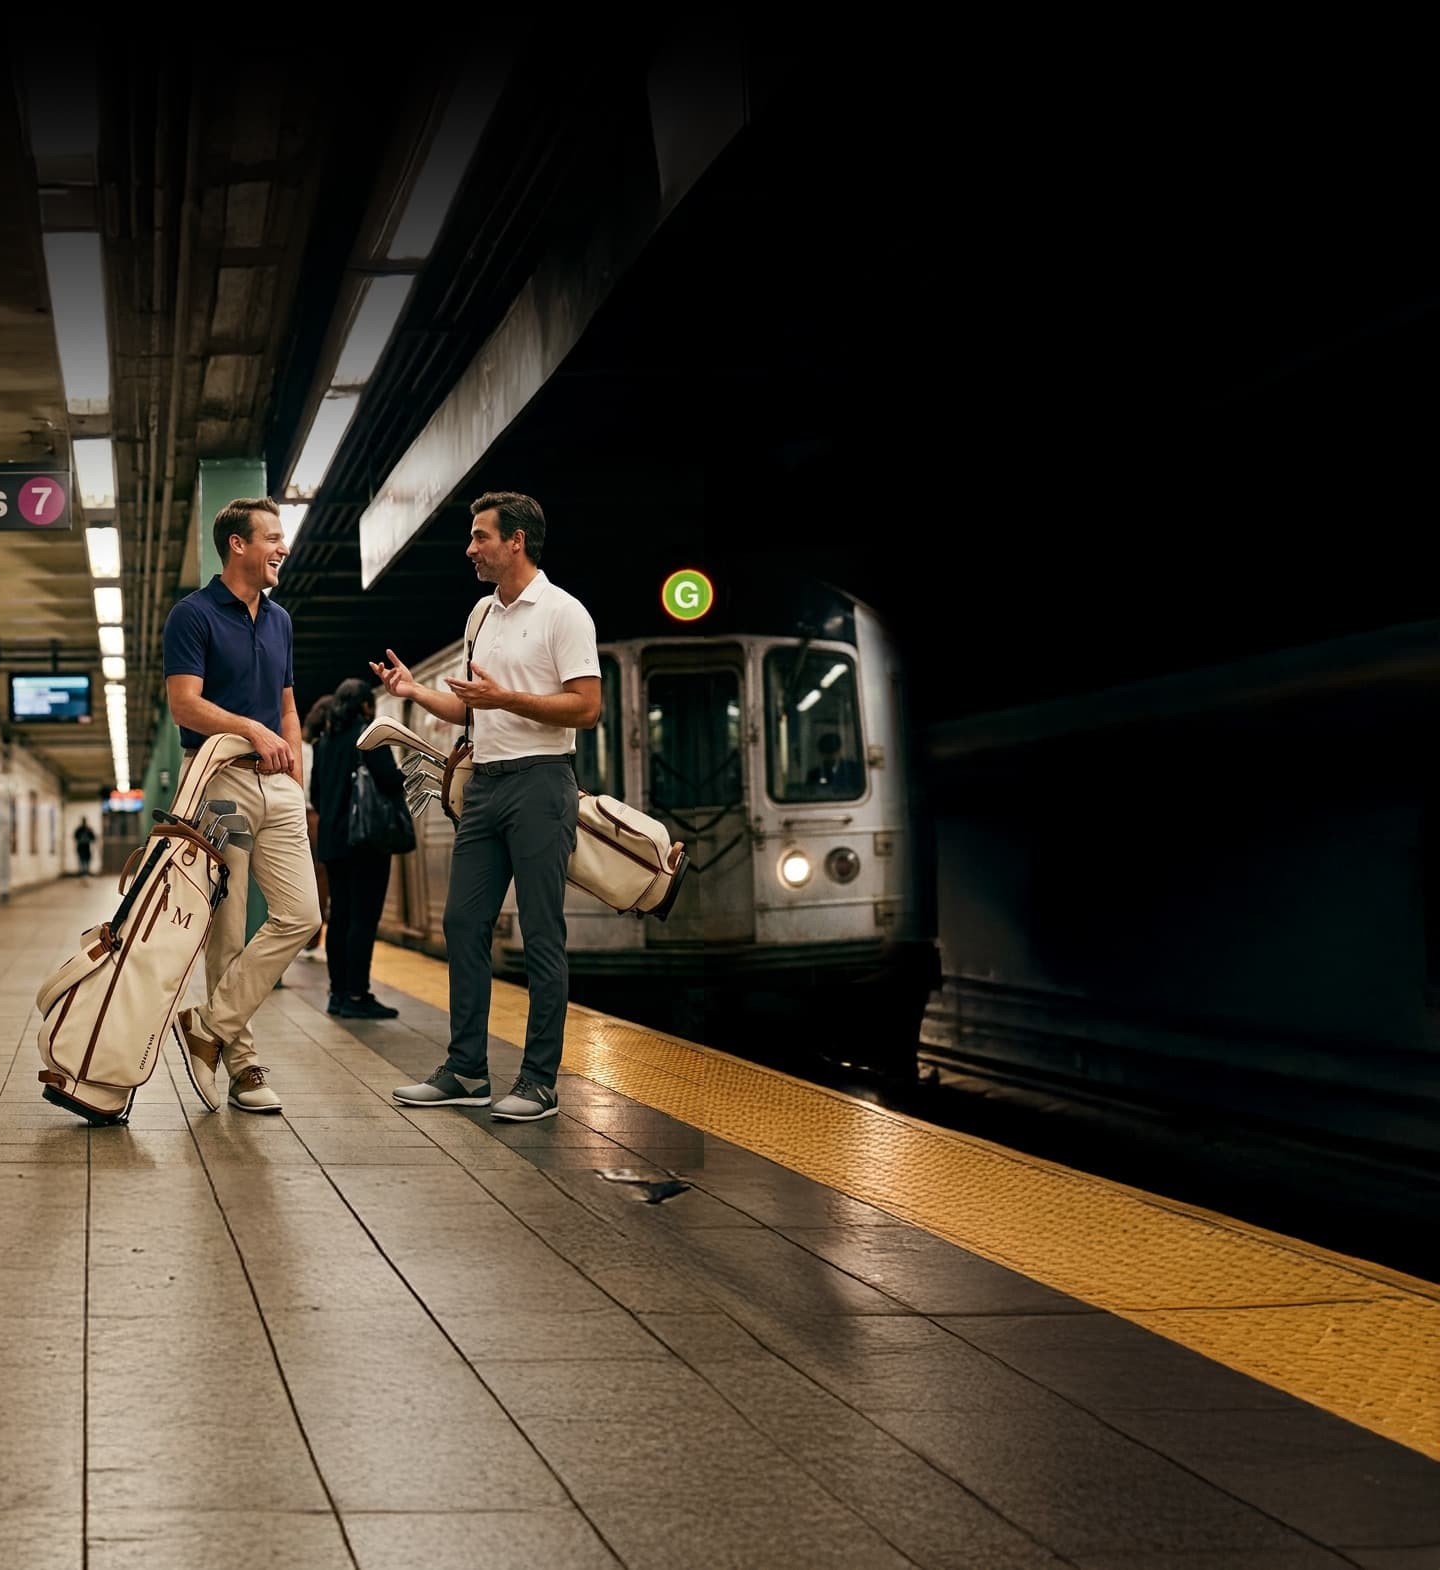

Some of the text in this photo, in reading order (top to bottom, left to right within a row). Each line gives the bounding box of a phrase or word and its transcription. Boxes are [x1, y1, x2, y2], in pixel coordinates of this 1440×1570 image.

[31, 487, 53, 516] 7
[674, 580, 699, 609] G
[170, 905, 195, 929] M
